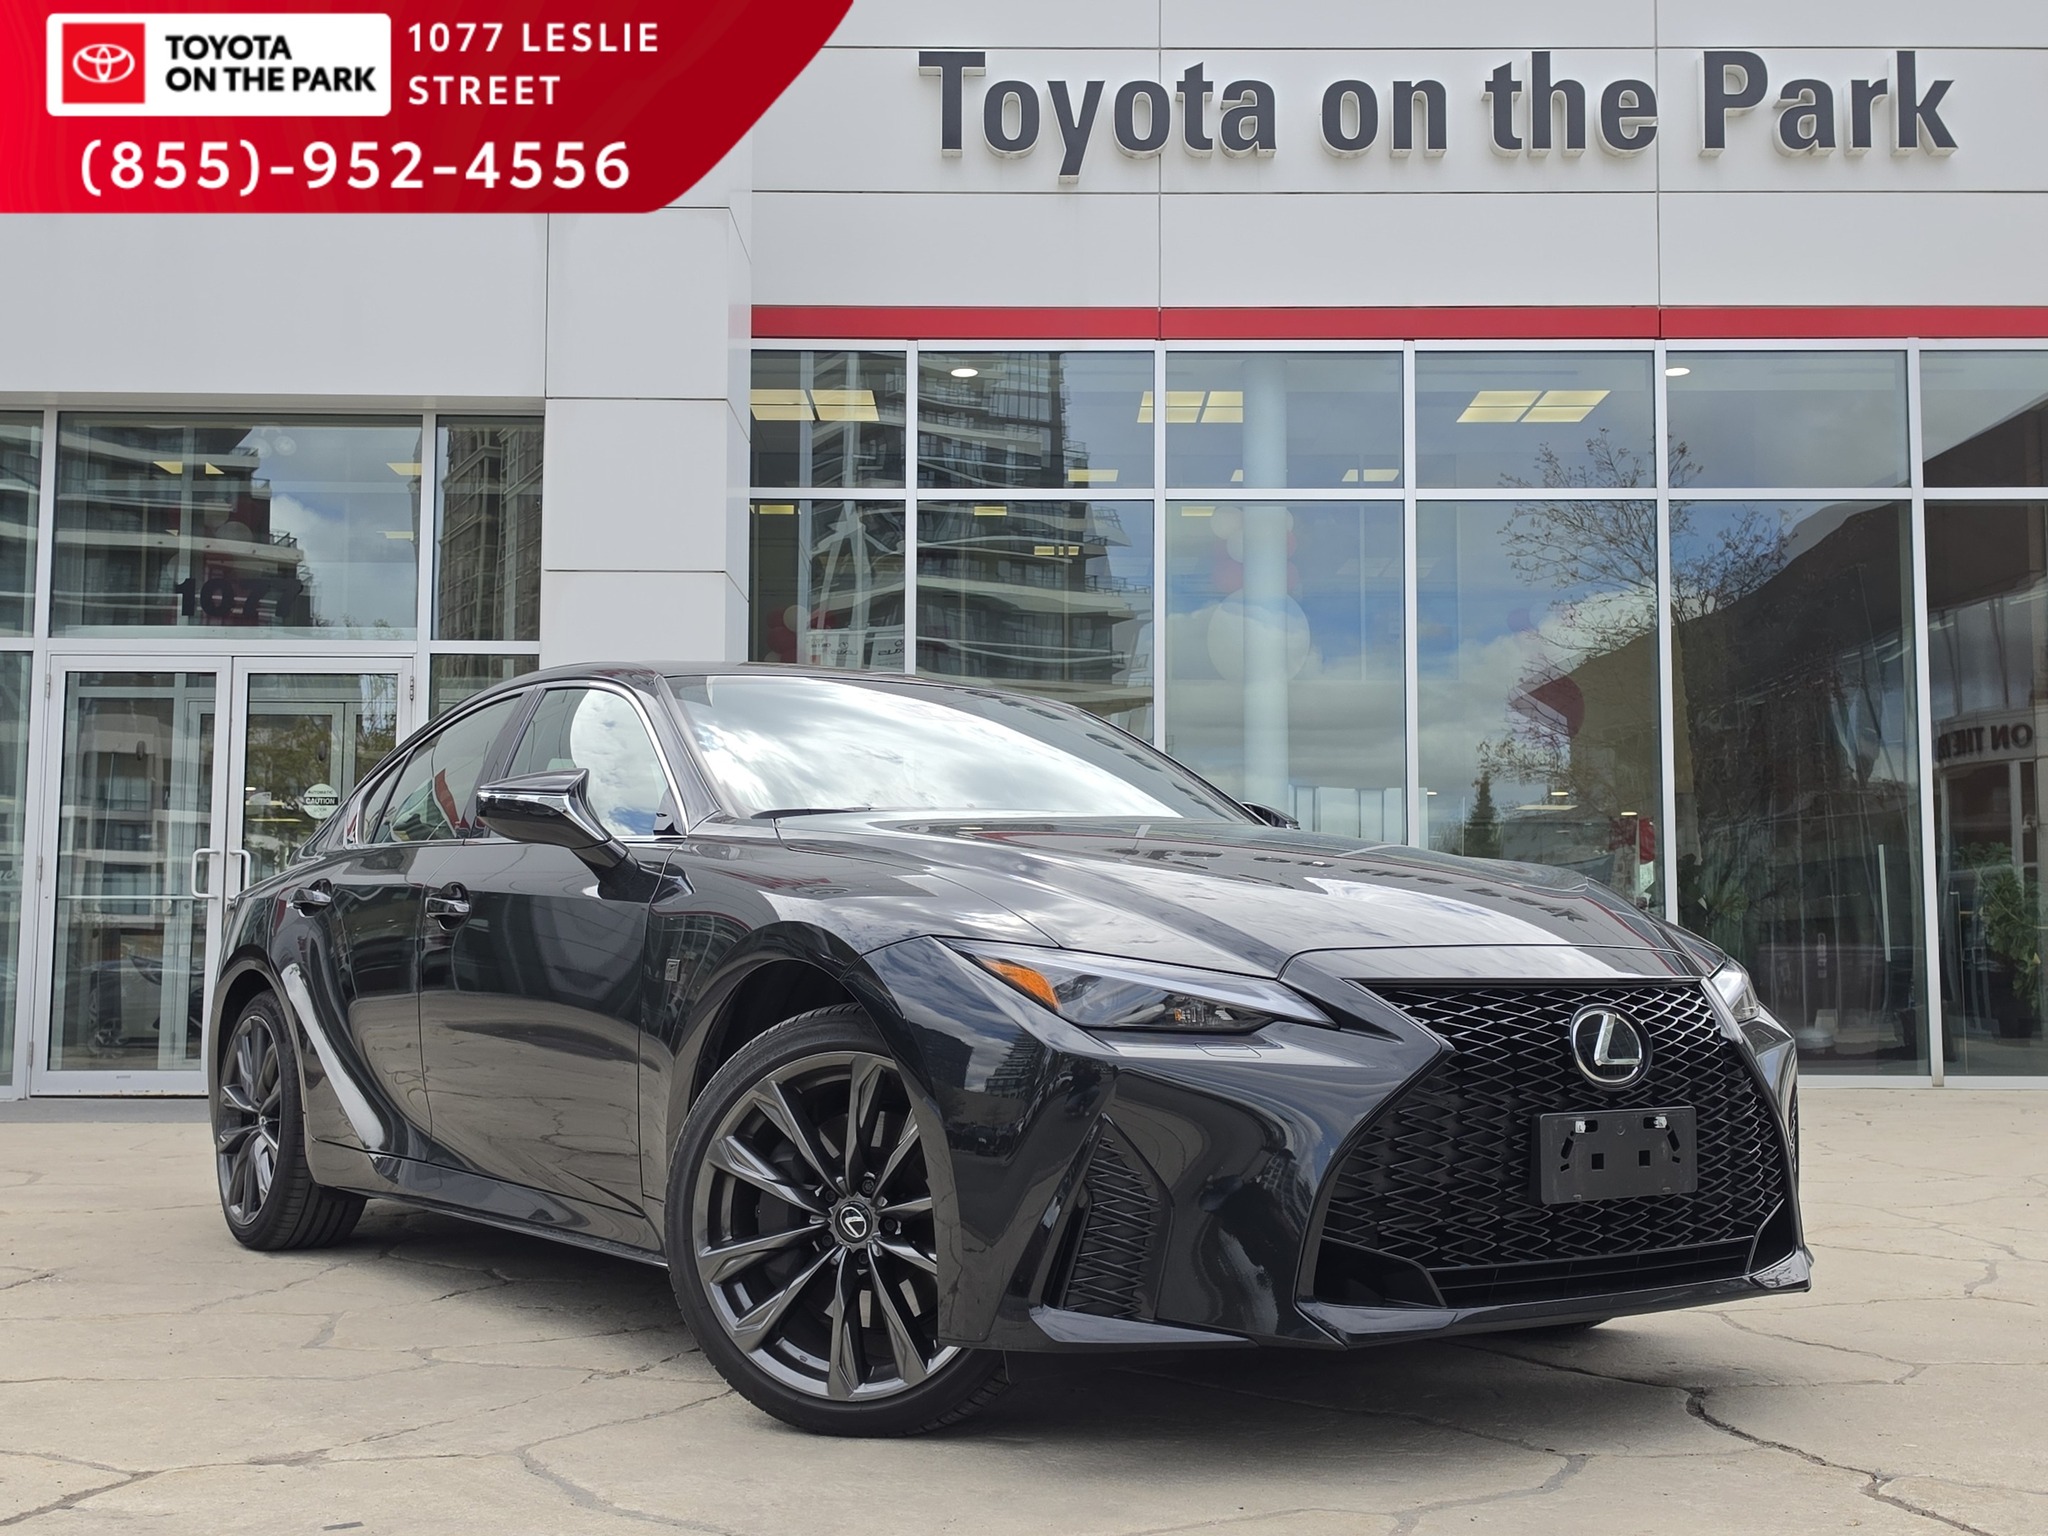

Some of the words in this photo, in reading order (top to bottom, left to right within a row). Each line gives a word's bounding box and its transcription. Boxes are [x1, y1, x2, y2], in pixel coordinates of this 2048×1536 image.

[919, 51, 1277, 180] Toyota
[1321, 79, 1448, 156] on
[1484, 51, 1659, 156] the
[1702, 50, 1959, 154] Park
[174, 577, 304, 617] 1077
[305, 797, 336, 805] CAUTION
